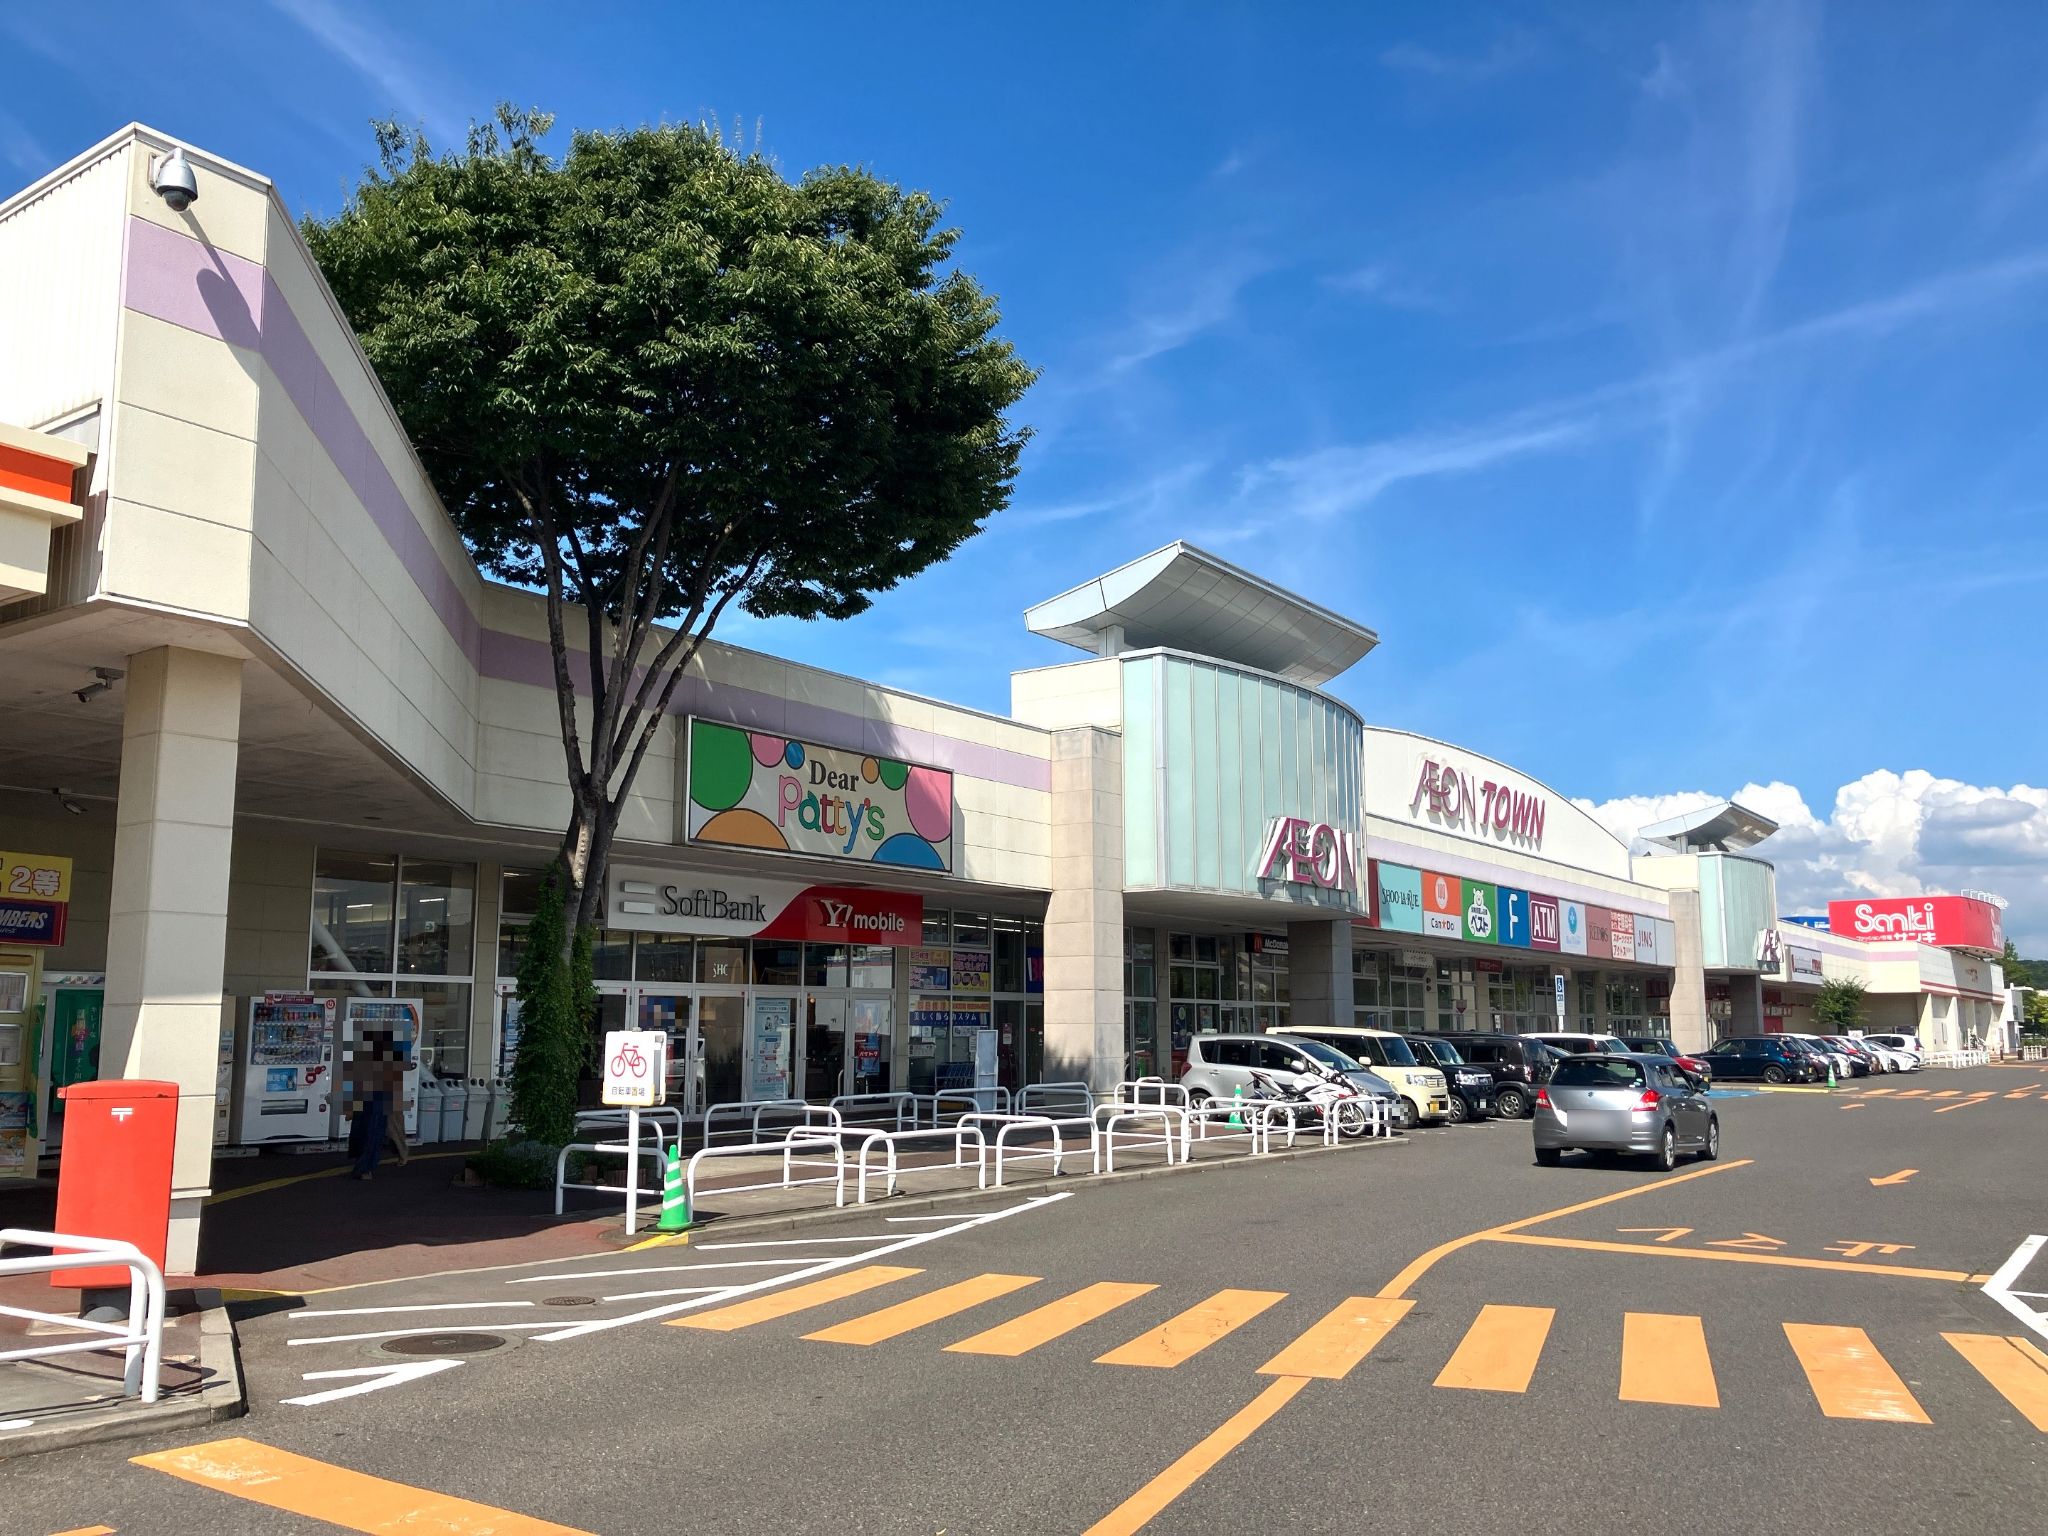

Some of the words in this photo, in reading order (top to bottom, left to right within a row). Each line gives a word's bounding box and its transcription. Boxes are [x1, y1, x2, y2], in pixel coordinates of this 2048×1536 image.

[809, 760, 859, 792] Dear
[1483, 781, 1545, 841] TOWN
[662, 885, 767, 922] SoftBank
[1855, 903, 1934, 932] Sanki
[1534, 906, 1556, 939] ATM
[1894, 932, 1936, 943] サンキ
